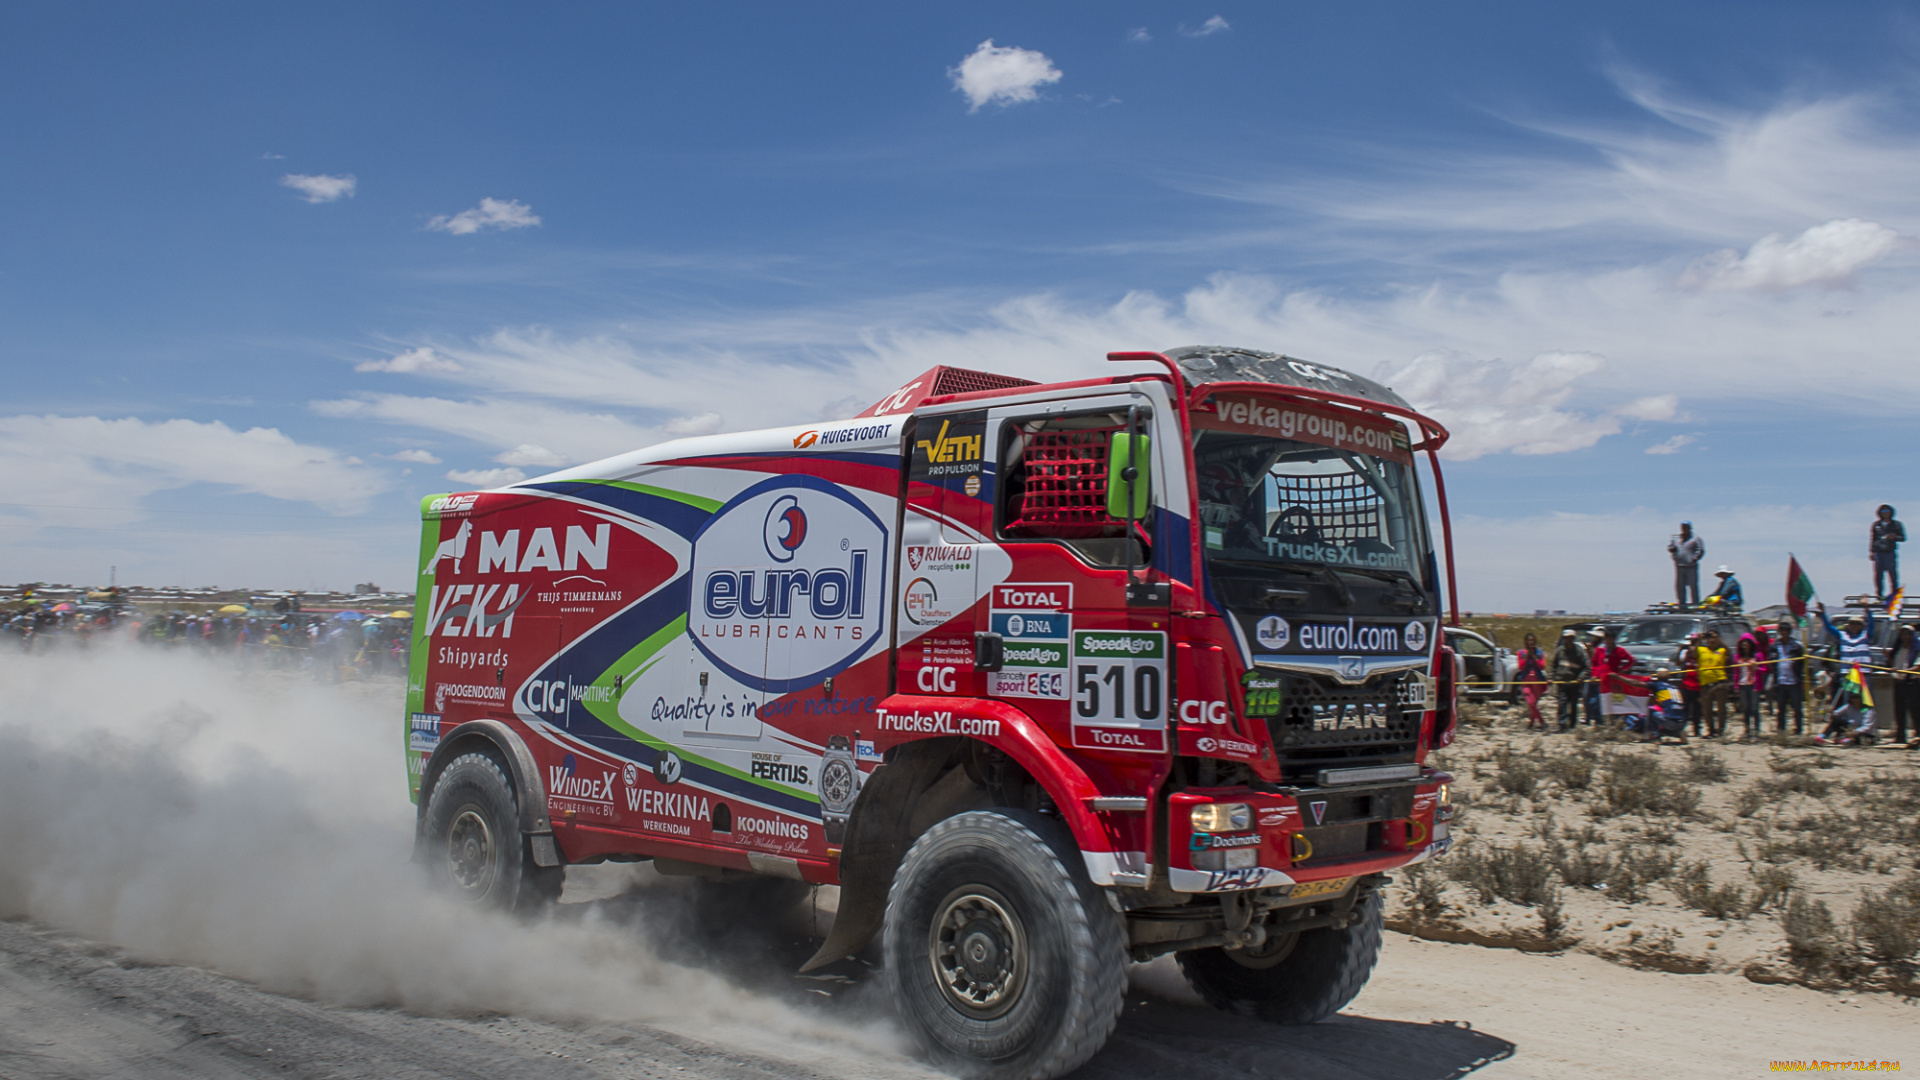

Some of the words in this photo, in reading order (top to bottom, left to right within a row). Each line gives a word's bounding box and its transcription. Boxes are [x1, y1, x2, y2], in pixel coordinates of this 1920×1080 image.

[874, 381, 922, 416] CIG
[820, 424, 892, 445] HUIGEVOORT
[1215, 400, 1393, 452] vekagroup.com
[917, 419, 981, 463] VETH
[928, 463, 980, 476] PROPULSION
[429, 496, 463, 511] GOLD
[478, 523, 611, 574] MAN
[924, 545, 972, 562] RIWALD
[1262, 536, 1402, 568] TrucksXL.com
[928, 563, 954, 572] recycling
[704, 549, 868, 620] eurol
[537, 592, 561, 604] THIJS
[563, 591, 622, 602] TIMMERMANS
[908, 593, 933, 610] 247
[1000, 589, 1062, 606] TOTAL
[424, 583, 520, 639] VEKA
[701, 625, 863, 640] LUBRICANTS
[1026, 619, 1052, 634] BNA
[1299, 617, 1398, 651] eurol.com
[1003, 647, 1061, 664] SpeedAgro
[1082, 636, 1155, 654] SpeedAgro
[438, 647, 509, 669] Shipyards
[917, 667, 956, 692] CIG
[996, 681, 1025, 693] sport
[445, 684, 506, 700] HOOGENDOORN
[527, 680, 565, 713] CIG
[571, 685, 610, 703] MARITIME
[1077, 664, 1160, 720] 510
[651, 696, 715, 731] Quality
[721, 695, 735, 718] is
[741, 694, 757, 718] in
[763, 700, 798, 719] our
[805, 690, 875, 715] nature
[1180, 700, 1227, 725] CIG
[1313, 704, 1387, 731] MAN
[411, 714, 440, 732] NMT
[876, 709, 1000, 736] TrucksXL.com
[1091, 730, 1145, 746] TOTAL
[752, 753, 773, 761] HOUSE
[751, 760, 808, 785] PERTIJS
[603, 805, 615, 817] BV
[625, 787, 711, 822] WERKINA
[643, 819, 691, 836] WERKENDAM
[735, 833, 753, 846] The
[754, 836, 783, 854] Wedding
[784, 840, 809, 854] Palace
[1212, 833, 1262, 848] Dockmarks
